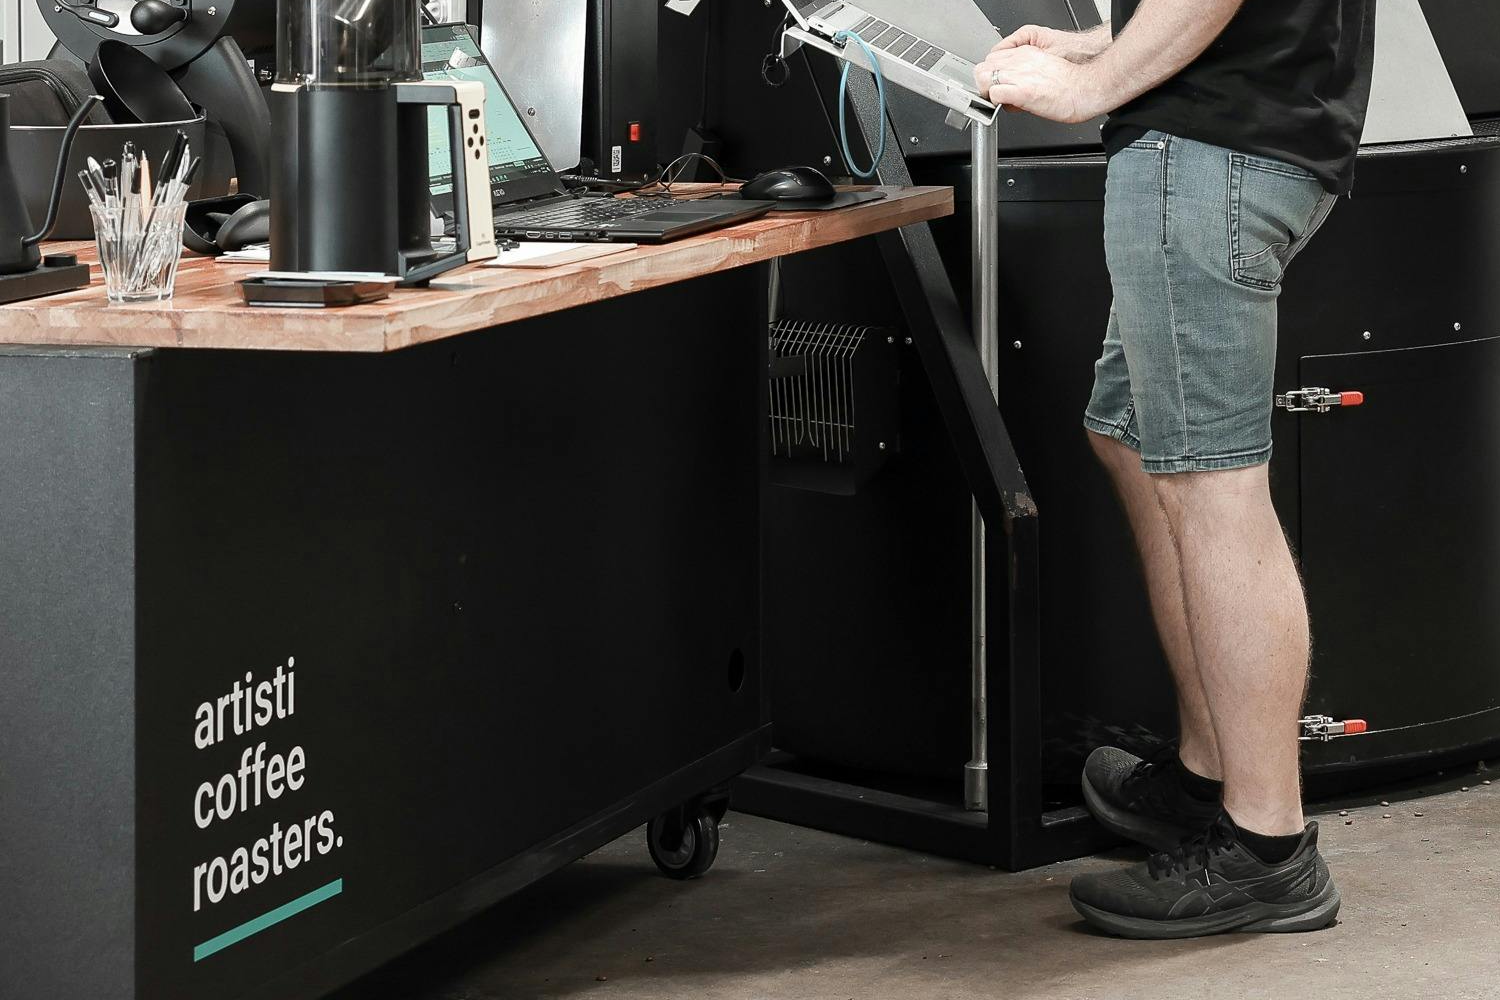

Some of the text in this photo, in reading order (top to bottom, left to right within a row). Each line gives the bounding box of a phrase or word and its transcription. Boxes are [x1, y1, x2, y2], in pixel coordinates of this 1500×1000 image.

[194, 656, 295, 750] artisti
[194, 741, 306, 829] coffee
[193, 810, 344, 912] roasters.
